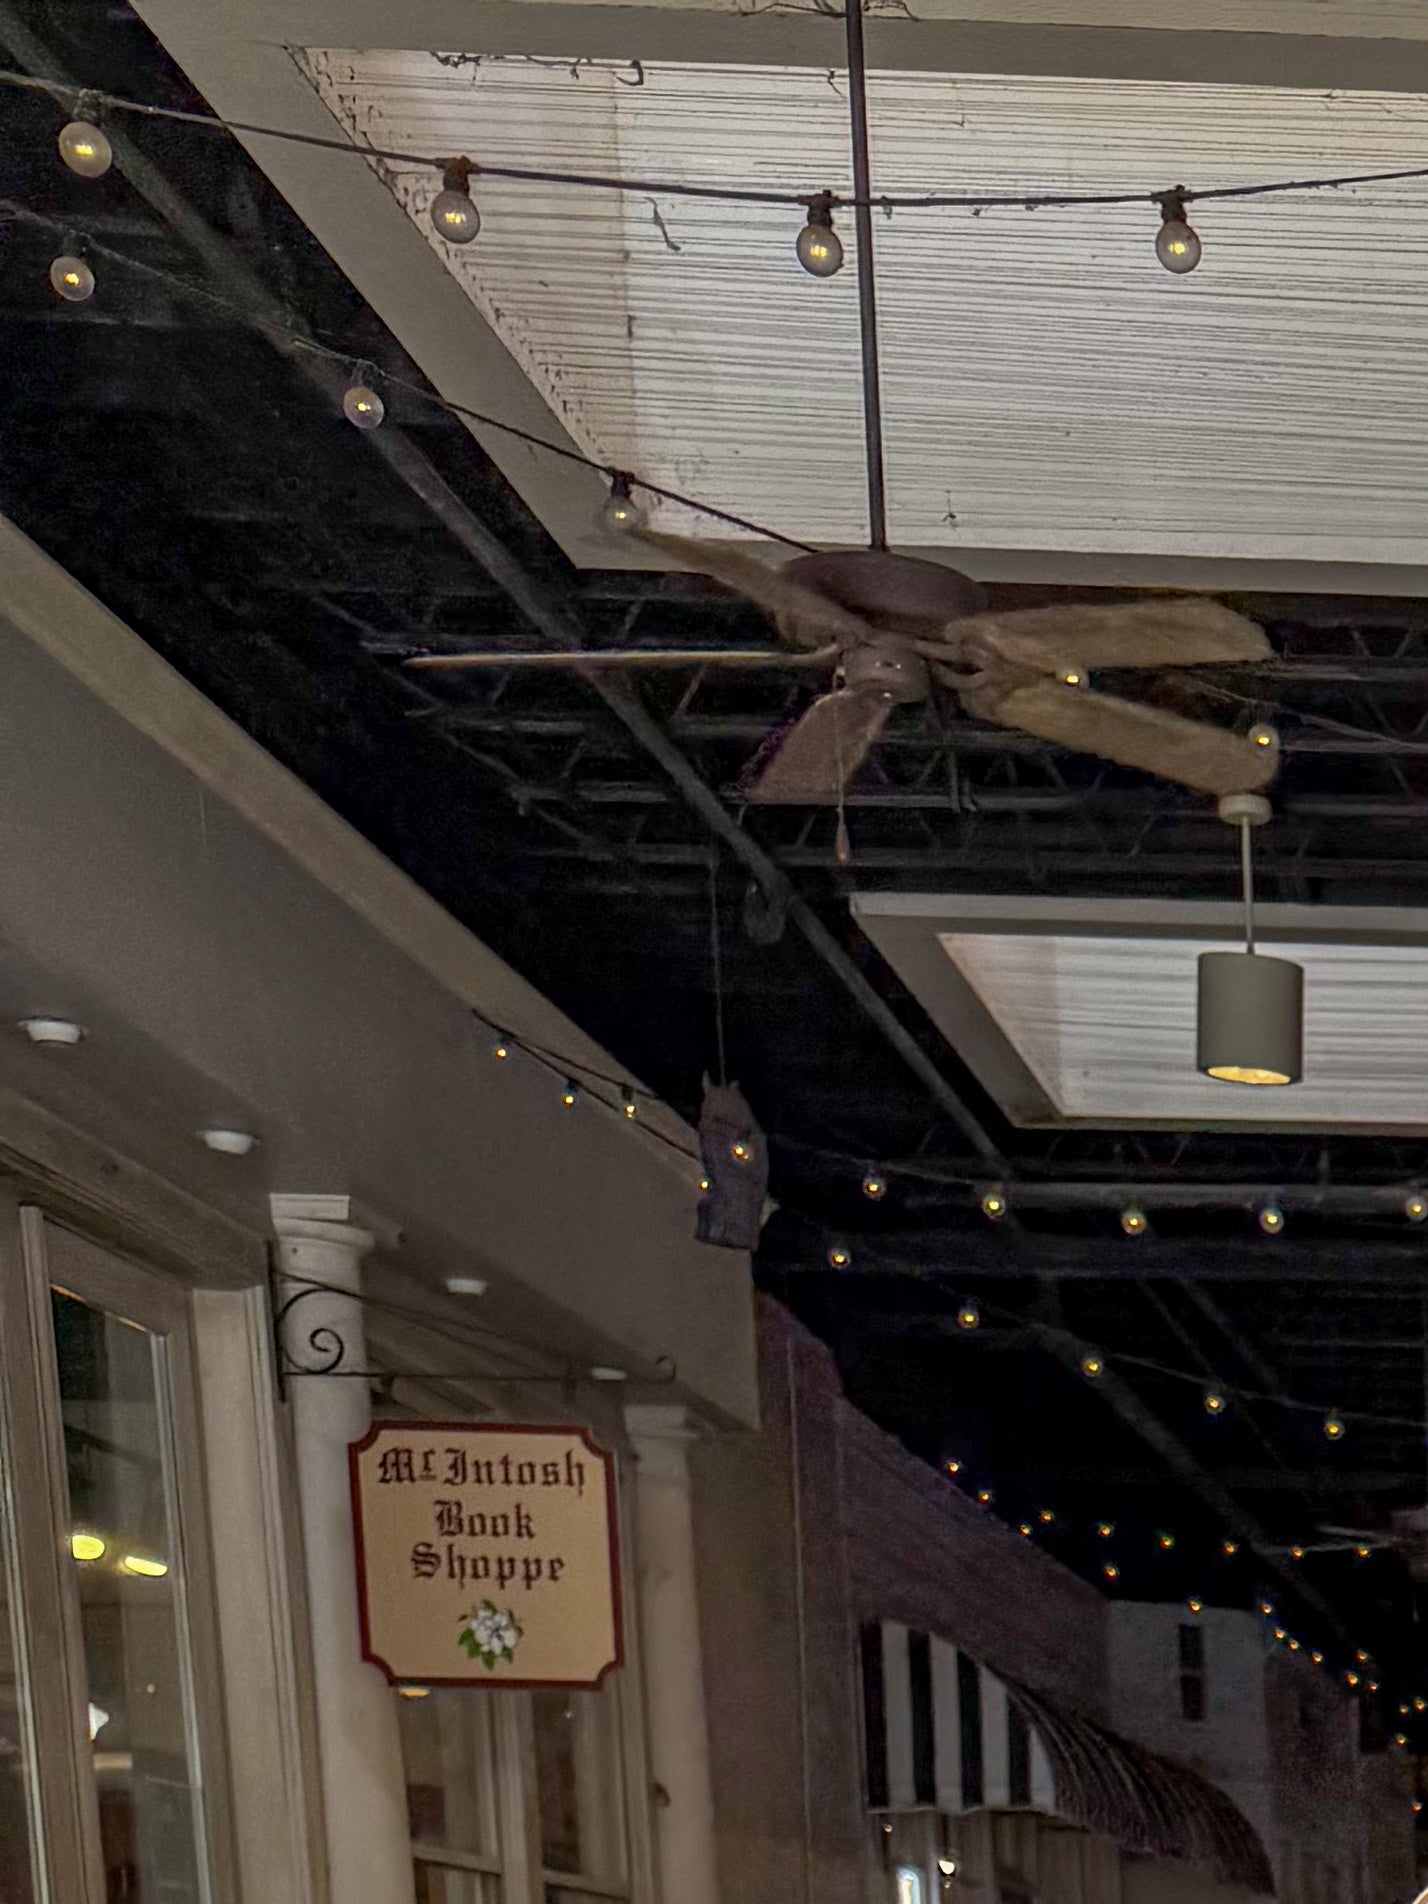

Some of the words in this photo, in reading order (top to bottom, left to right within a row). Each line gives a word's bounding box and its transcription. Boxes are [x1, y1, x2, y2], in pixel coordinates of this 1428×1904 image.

[378, 1447, 585, 1496] McIntosh
[434, 1500, 536, 1539] Book
[411, 1542, 565, 1590] Shoppe
